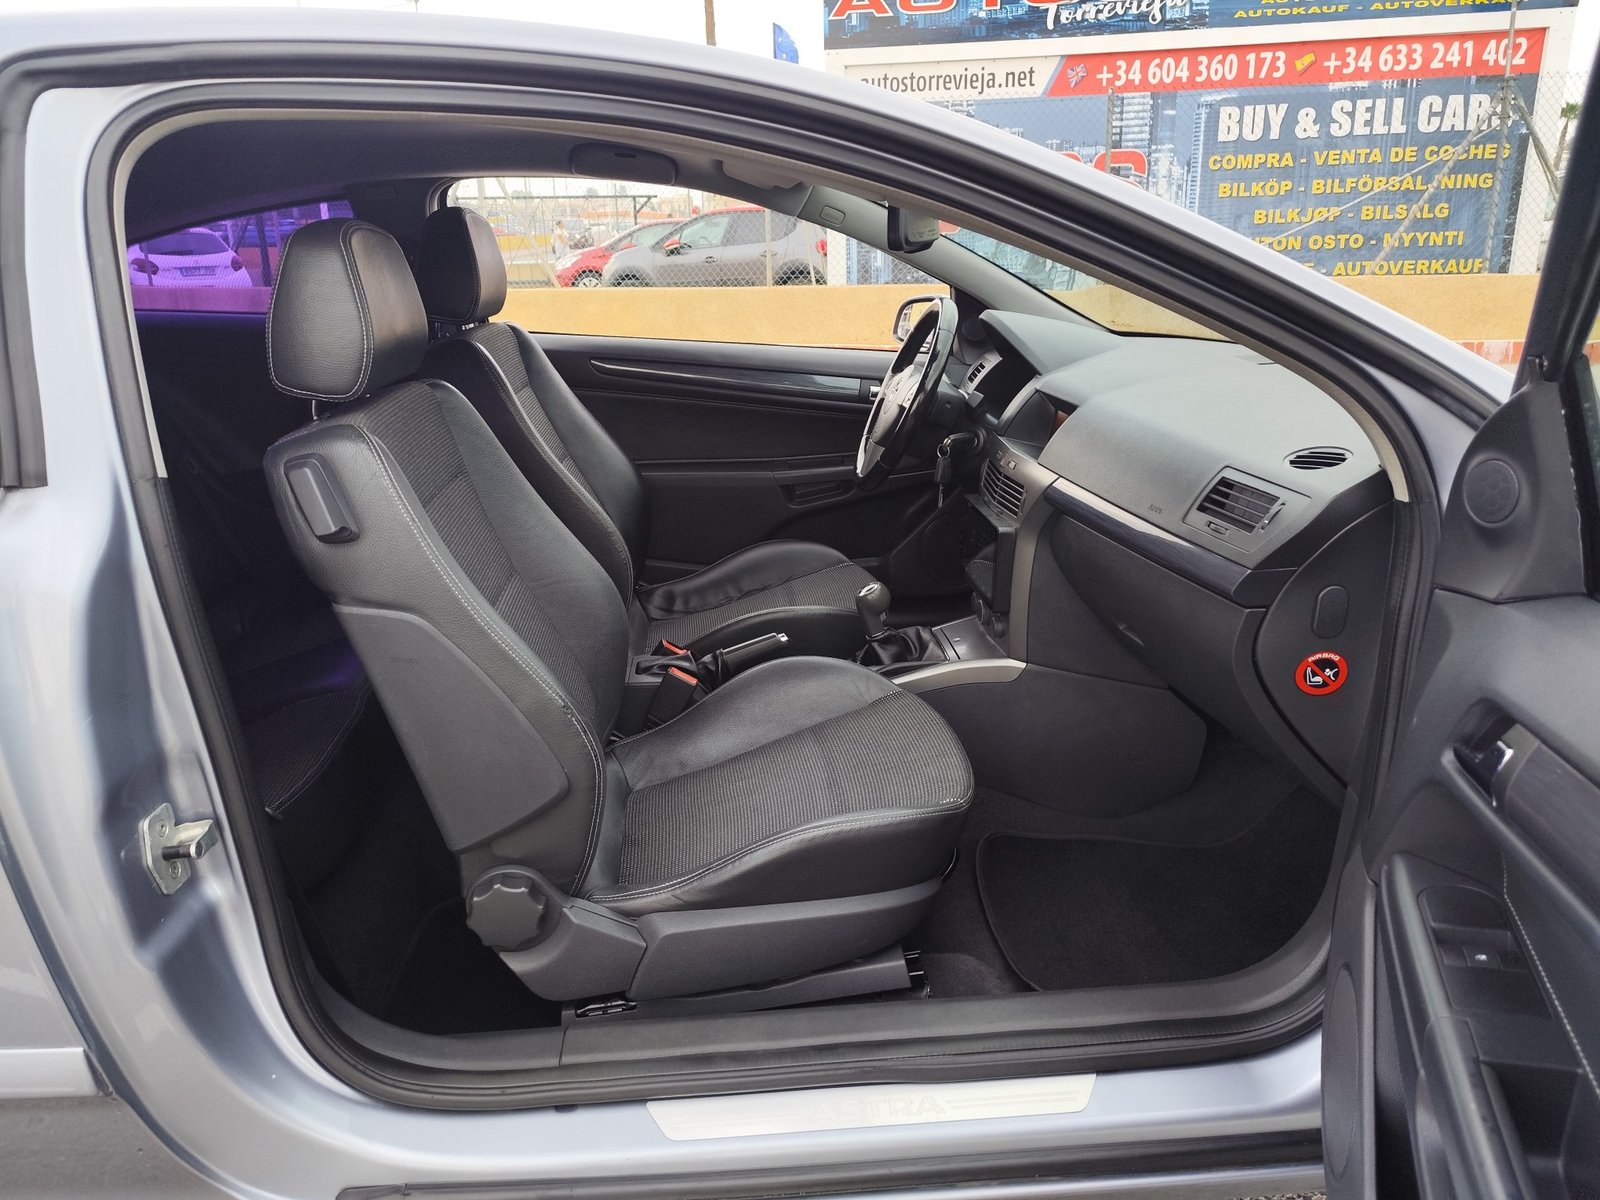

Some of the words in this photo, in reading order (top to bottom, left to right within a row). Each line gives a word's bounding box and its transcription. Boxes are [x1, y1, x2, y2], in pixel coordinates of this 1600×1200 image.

[1234, 5, 1350, 18] AUTOKAUF
[1324, 47, 1372, 75] +34
[1379, 44, 1423, 72] 633
[1430, 41, 1474, 69] 241
[1482, 38, 1528, 66] 402
[1096, 59, 1142, 87] +34
[1147, 56, 1190, 85] 604
[1195, 54, 1239, 82] 360
[1246, 51, 1287, 79] 173
[1217, 103, 1289, 142] BUY
[1294, 107, 1320, 139] &
[1329, 98, 1407, 137] SELL
[1208, 151, 1294, 171] COMPRA
[1313, 147, 1382, 167] VENTA
[1389, 146, 1418, 163] DE
[1218, 177, 1293, 198] BILKÖP
[1308, 233, 1364, 250] OSTO
[1382, 231, 1465, 248] MYYNTI
[1308, 652, 1341, 662] AIRBAG
